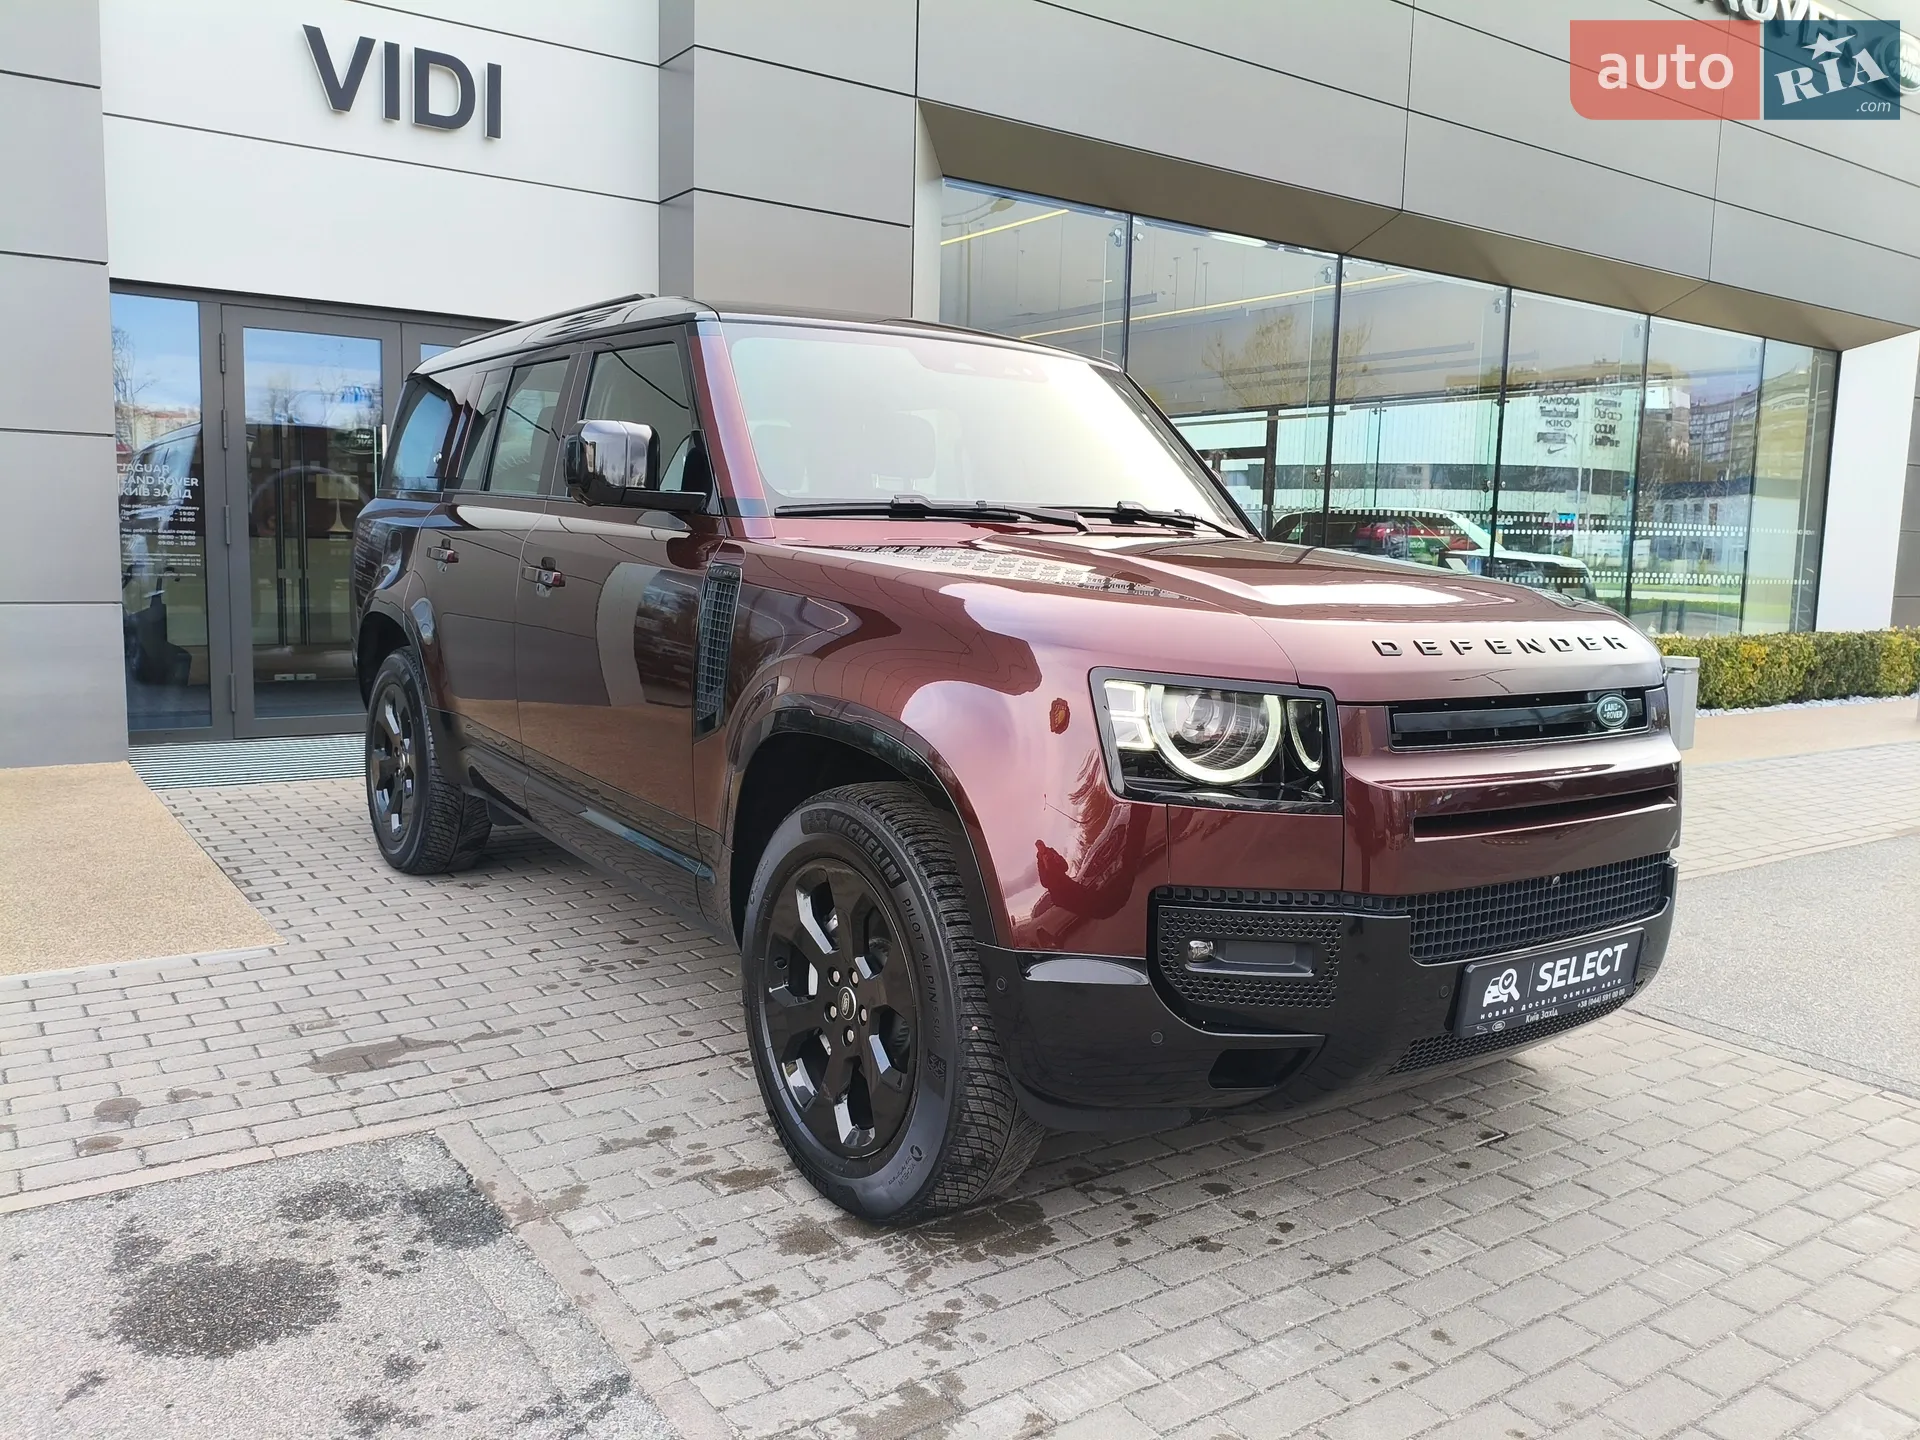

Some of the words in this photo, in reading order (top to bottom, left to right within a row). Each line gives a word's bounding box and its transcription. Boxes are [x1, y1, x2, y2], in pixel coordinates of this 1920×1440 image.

[302, 24, 502, 139] VIDI
[1538, 396, 1580, 406] PANDORA
[1545, 419, 1572, 428] KIKO
[120, 464, 170, 473] JAGUAR
[158, 477, 199, 486] ROVER
[120, 486, 150, 497] КИЇВ
[1371, 636, 1628, 656] DEFENDER
[1604, 703, 1617, 711] LAND
[1606, 711, 1623, 719] ROVER
[829, 813, 900, 883] MICHELIN
[902, 898, 925, 942] PILOT
[920, 952, 938, 1002] ALPIN
[1536, 943, 1628, 992] SELECT
[1480, 1006, 1514, 1020] НОВИЙ
[1521, 996, 1557, 1011] ДОСВІД
